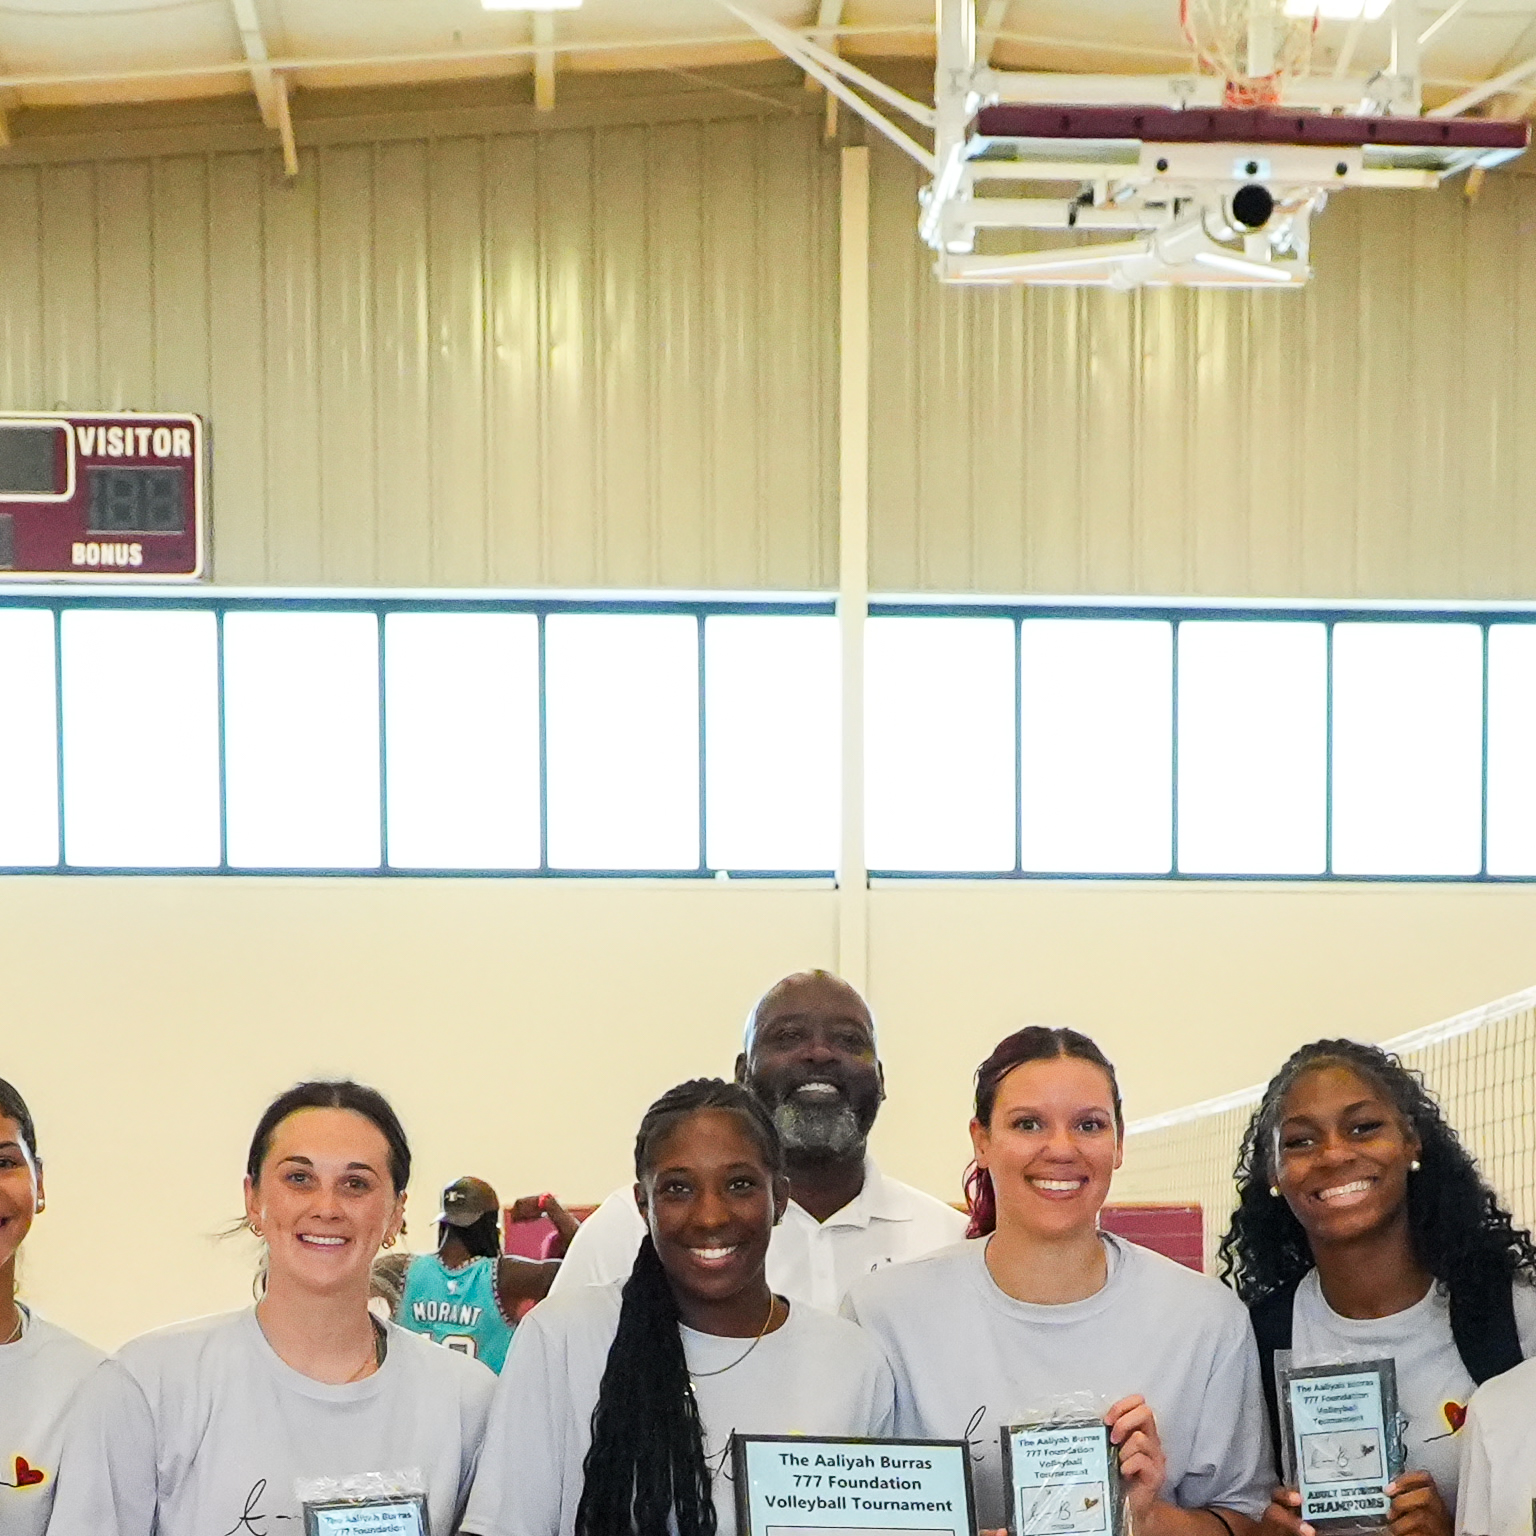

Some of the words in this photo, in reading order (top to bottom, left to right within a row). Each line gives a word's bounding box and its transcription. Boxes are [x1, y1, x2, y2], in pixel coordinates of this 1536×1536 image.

[77, 427, 192, 457] VISITOR
[73, 543, 143, 567] BONUS
[413, 1300, 482, 1327] MORANT
[779, 1453, 809, 1467] The
[815, 1455, 875, 1471] Aaliyah
[880, 1456, 933, 1470] Burras
[793, 1475, 822, 1488] 777
[828, 1476, 922, 1490] Foundation
[765, 1496, 846, 1512] Volleyball
[851, 1497, 953, 1512] Tournament
